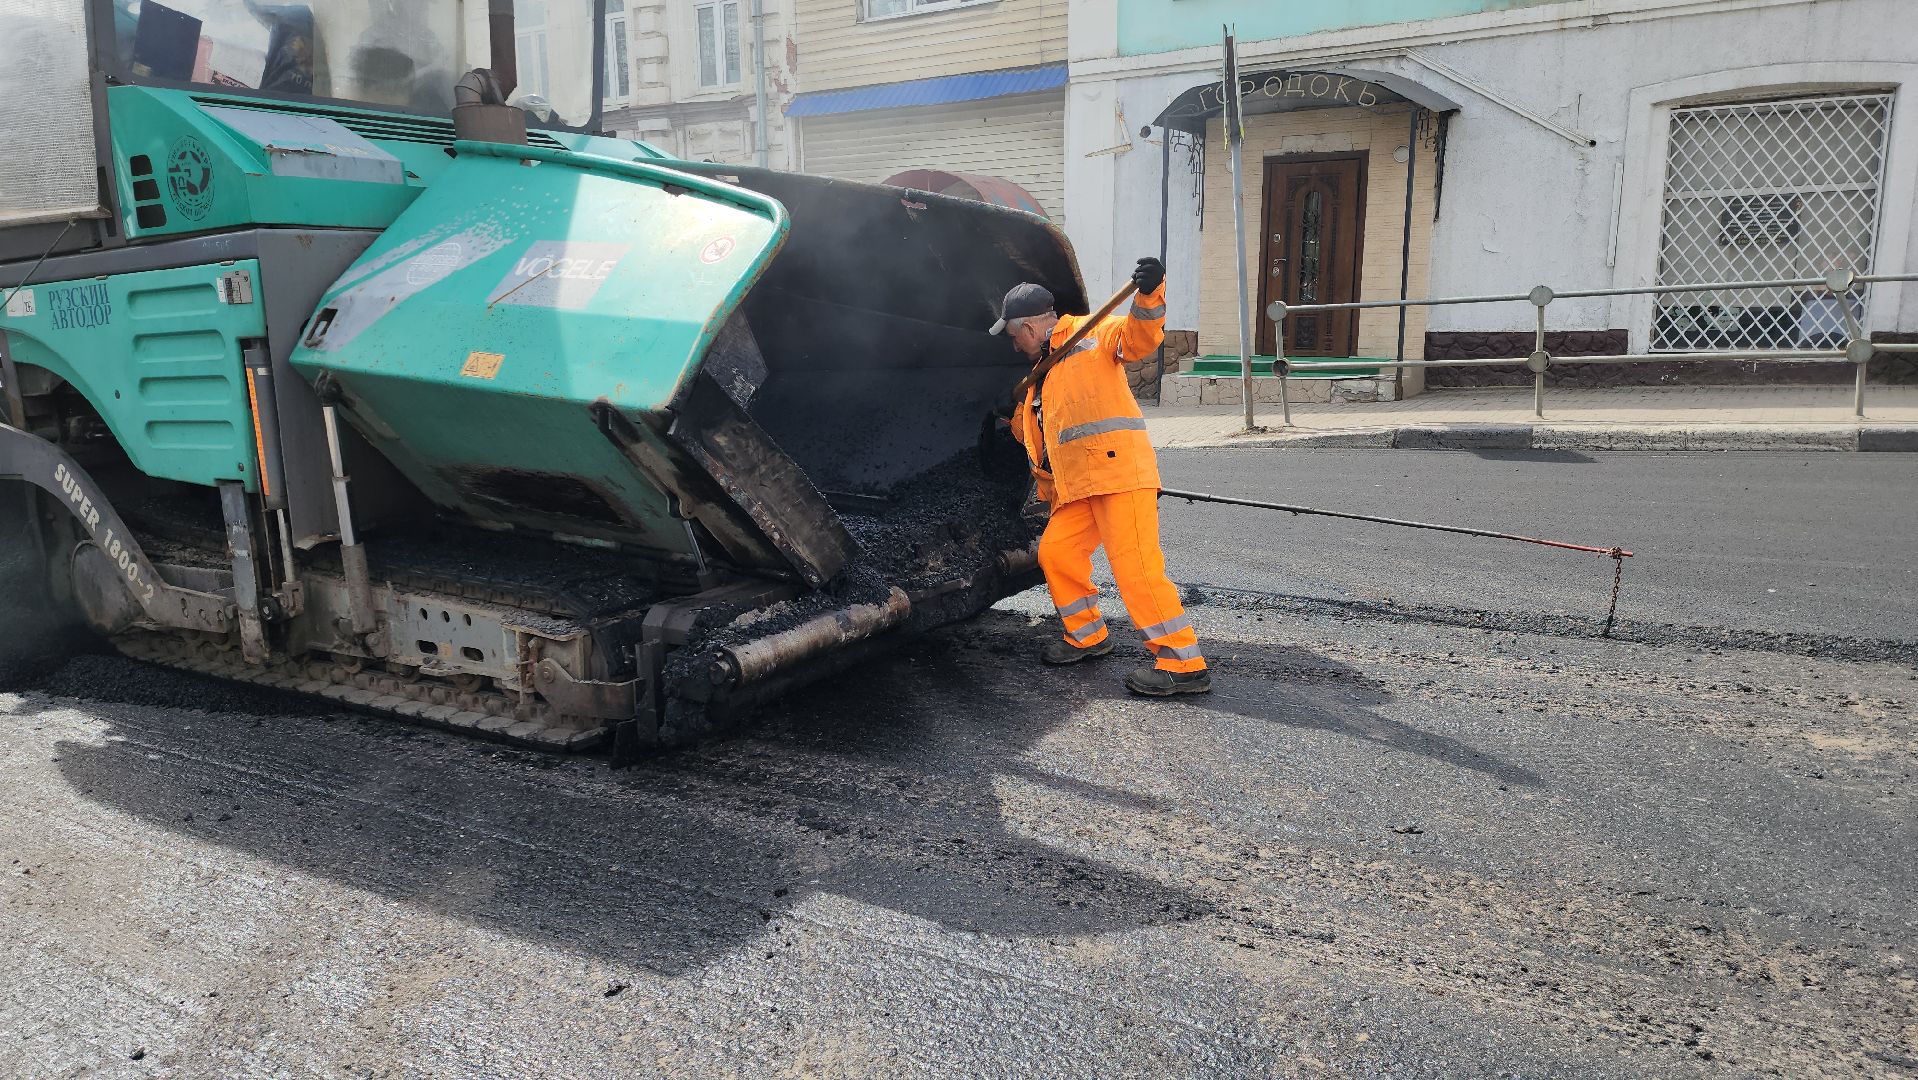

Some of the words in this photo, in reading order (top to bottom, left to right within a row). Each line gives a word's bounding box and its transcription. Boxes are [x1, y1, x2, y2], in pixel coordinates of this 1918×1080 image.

[52, 305, 112, 330] АВТОДОР
[54, 463, 100, 532] SUPER
[103, 528, 154, 605] 1800-2
